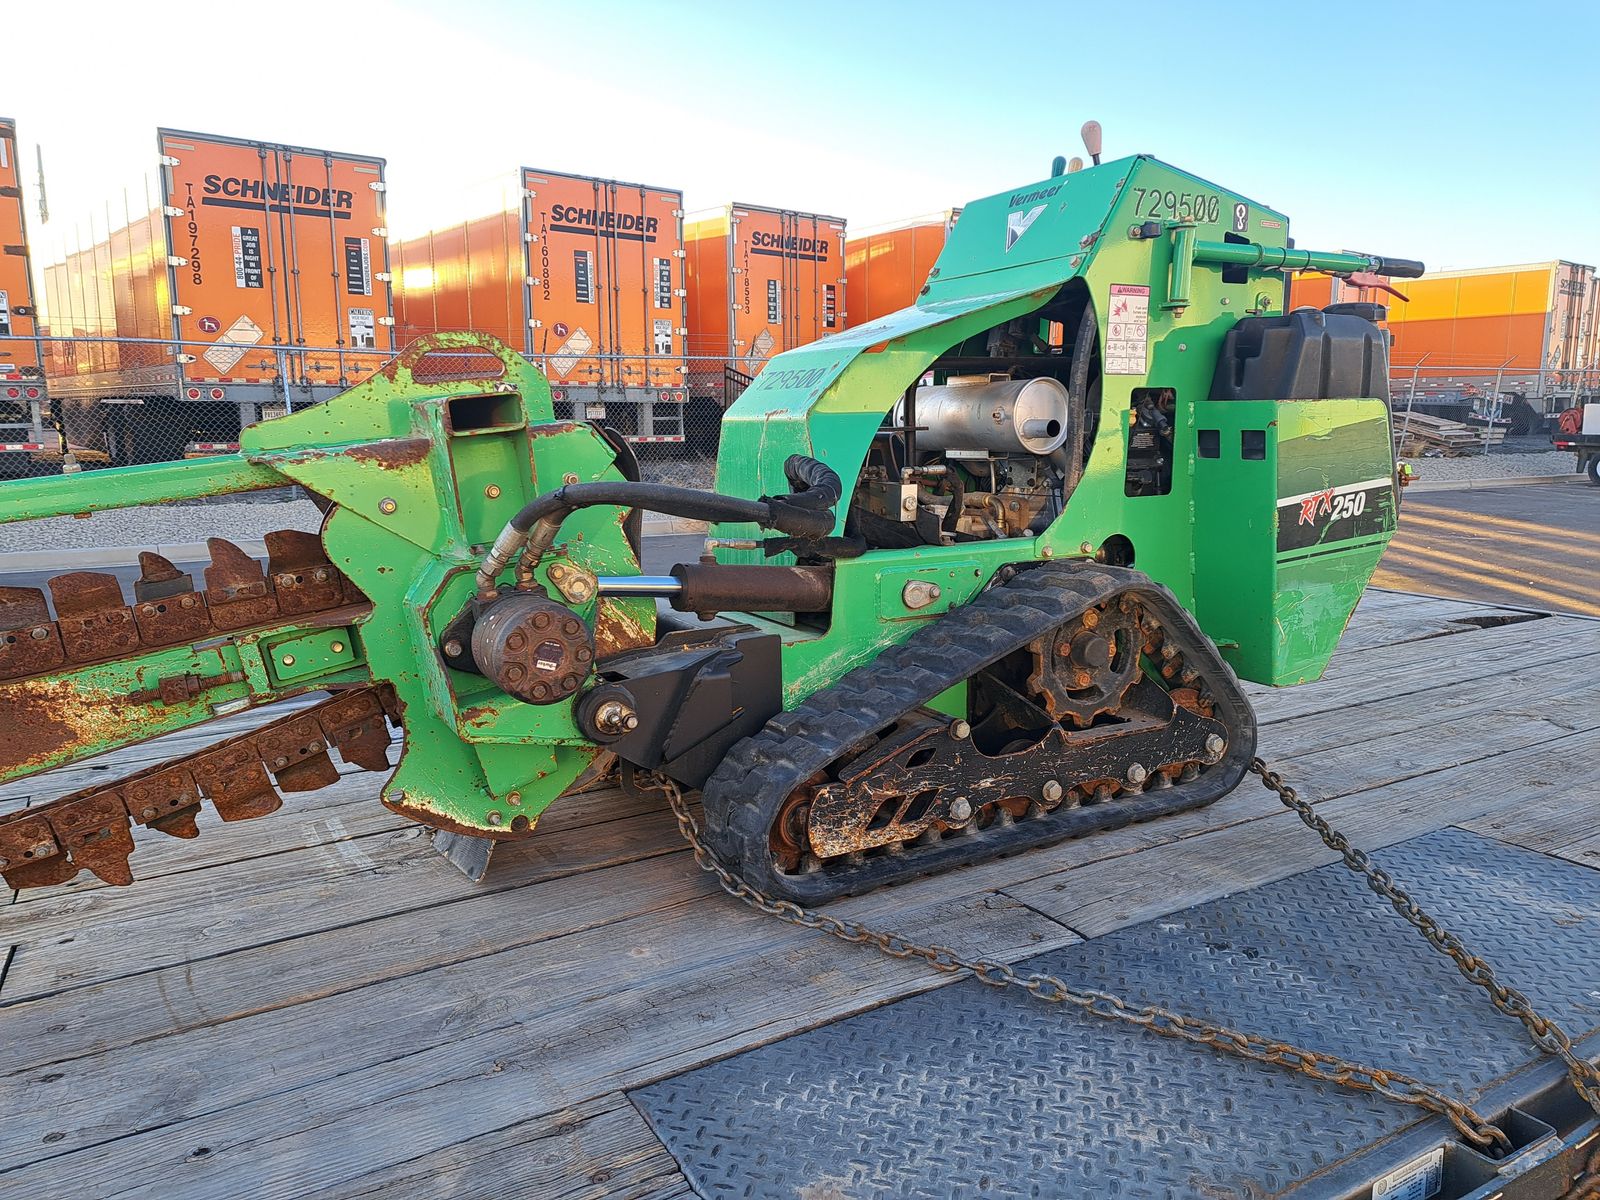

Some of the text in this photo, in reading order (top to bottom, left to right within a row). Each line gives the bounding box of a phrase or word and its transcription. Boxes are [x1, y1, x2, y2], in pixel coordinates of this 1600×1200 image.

[203, 174, 353, 209] SCHNEIDER
[1009, 185, 1063, 208] Vermeer
[1134, 188, 1220, 223] 729500
[185, 183, 203, 285] TA197298
[551, 204, 658, 233] SCHNEIDER
[233, 233, 244, 280] 800-44-PRIDE
[540, 212, 550, 300] TA160882
[752, 231, 828, 254] SCHNEIDER
[756, 368, 827, 391] 729500
[1299, 487, 1366, 527] RTX 250
